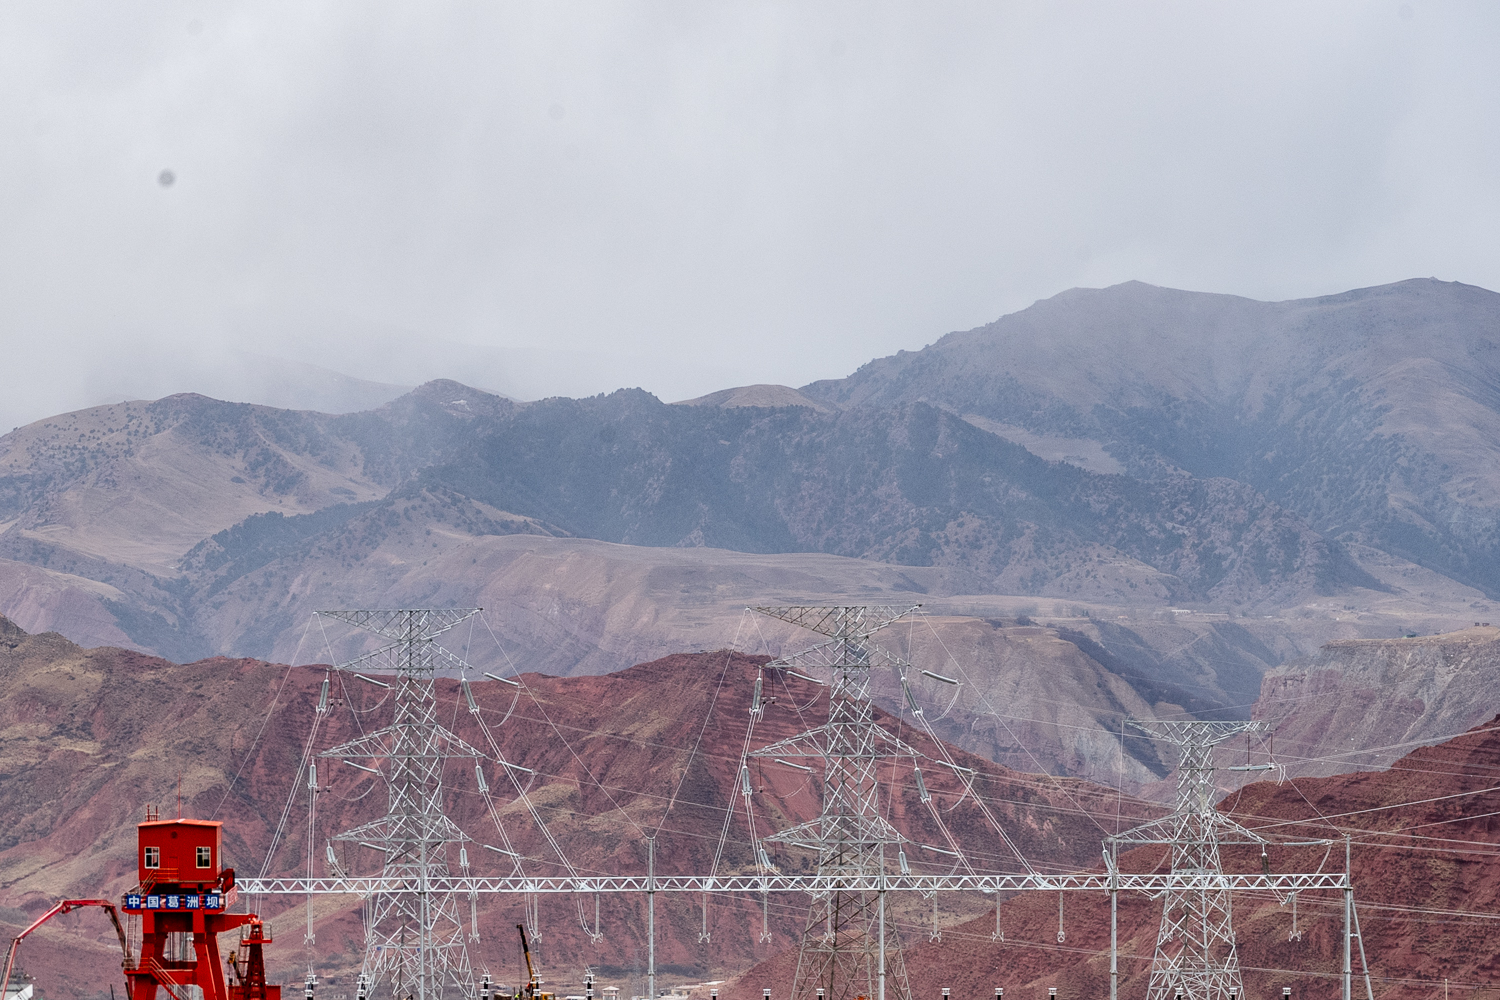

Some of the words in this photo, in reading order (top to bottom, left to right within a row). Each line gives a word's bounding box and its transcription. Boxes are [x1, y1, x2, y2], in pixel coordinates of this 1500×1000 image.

[128, 896, 218, 908] 中国葛洲坝
